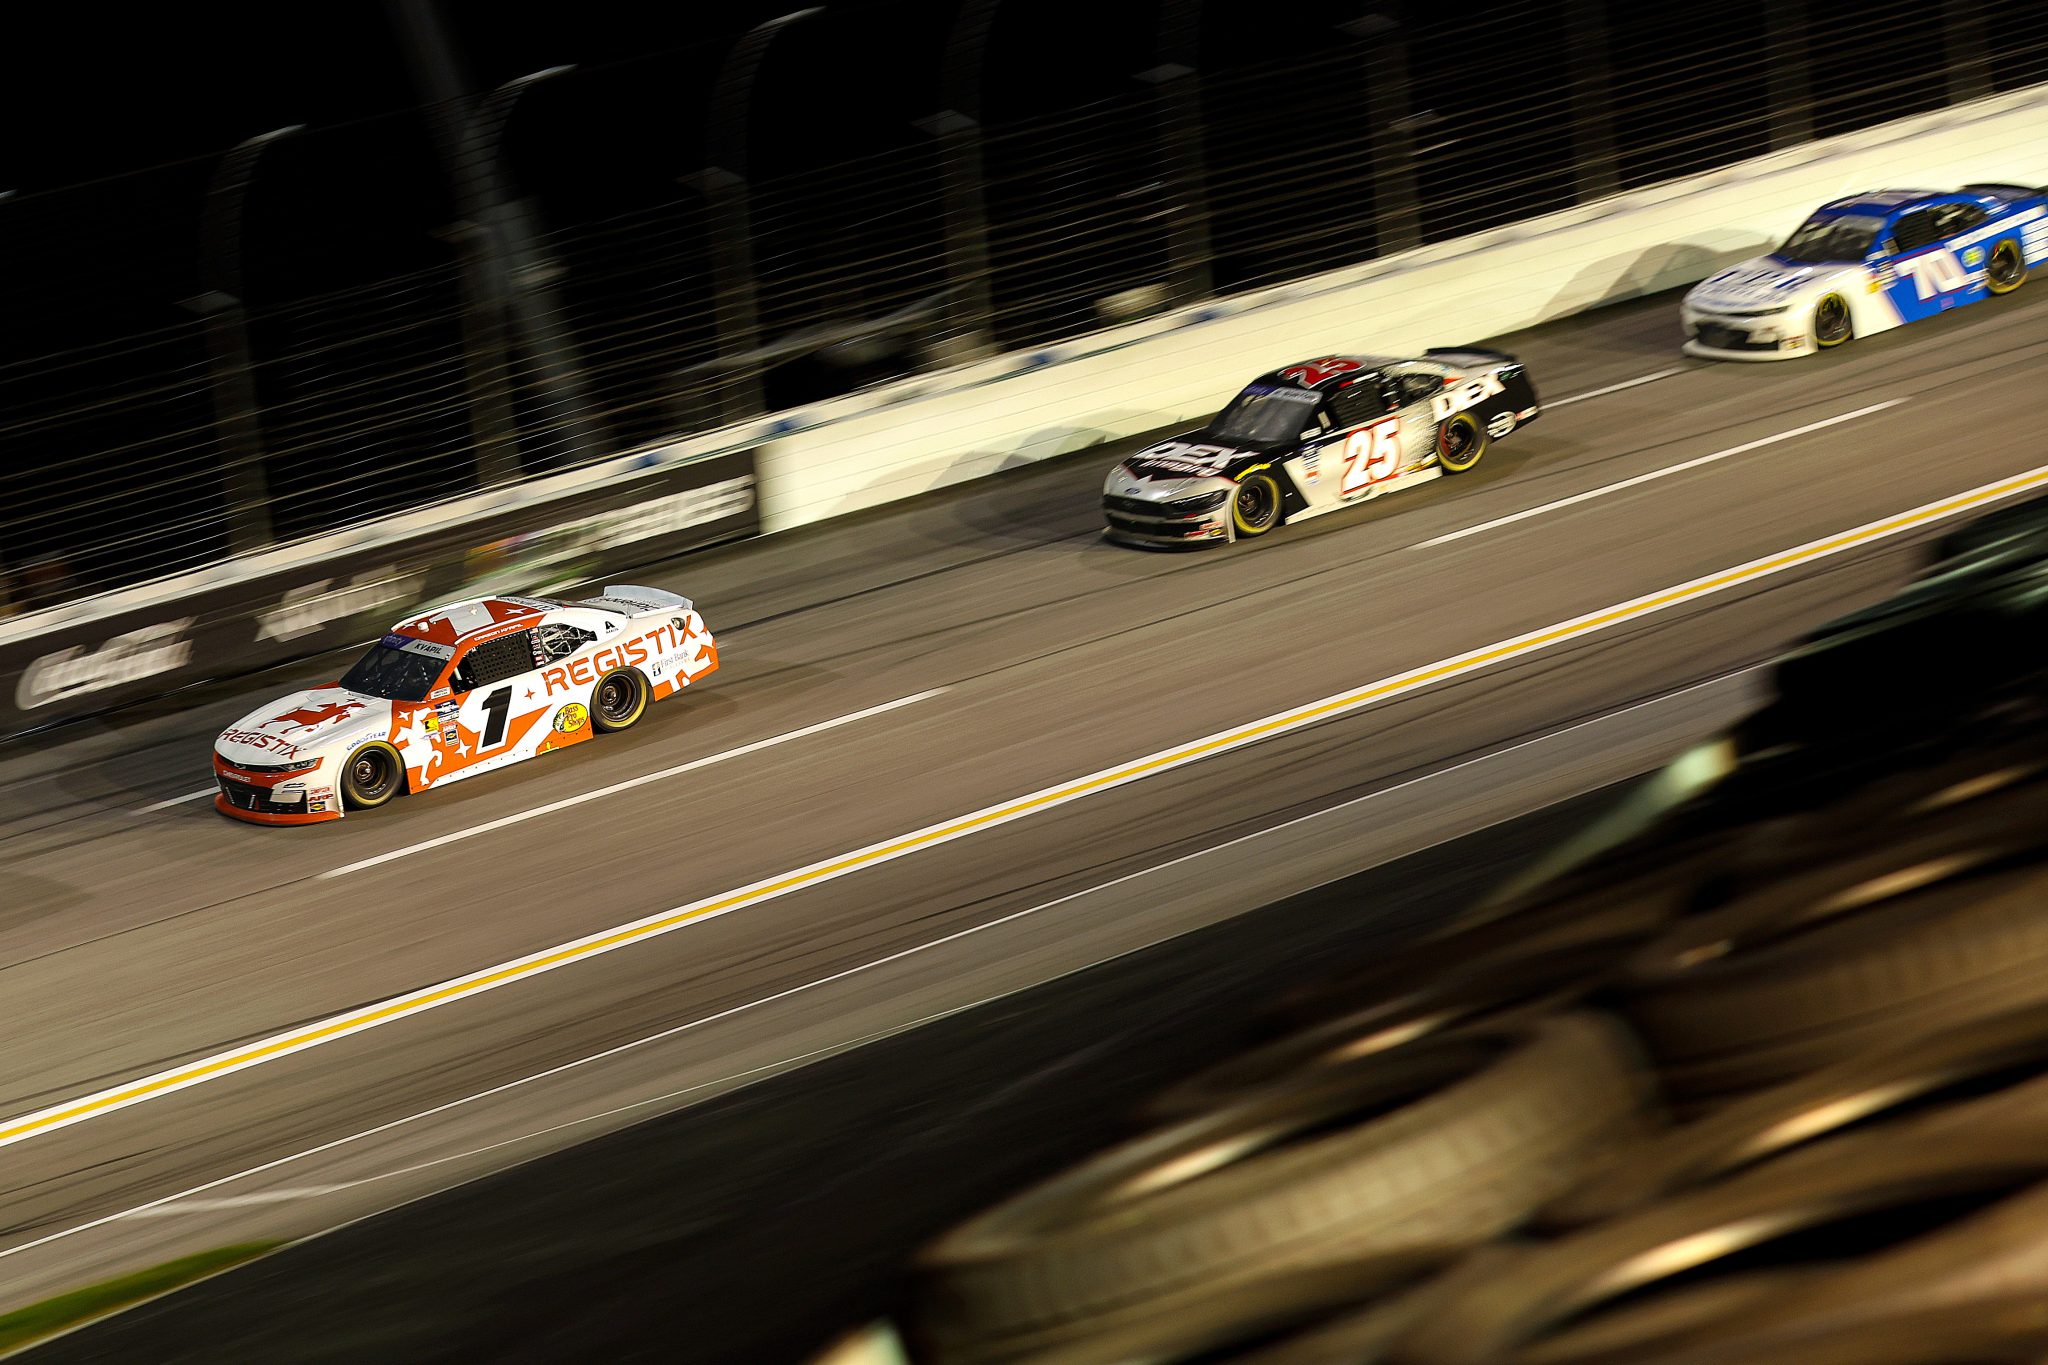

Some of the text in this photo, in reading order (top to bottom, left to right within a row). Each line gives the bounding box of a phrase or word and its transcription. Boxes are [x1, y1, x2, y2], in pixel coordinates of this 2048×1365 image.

[1279, 354, 1368, 389] 25
[1429, 372, 1506, 422] DEX
[1131, 442, 1261, 469] DEX
[1341, 415, 1401, 496] 25
[414, 643, 443, 655] KVAPIL
[541, 615, 698, 697] REGISTIX
[481, 685, 512, 748] 1
[565, 705, 578, 716] Bass
[566, 713, 577, 721] Pro
[568, 717, 585, 728] Shops
[220, 729, 299, 760] REGISTIX
